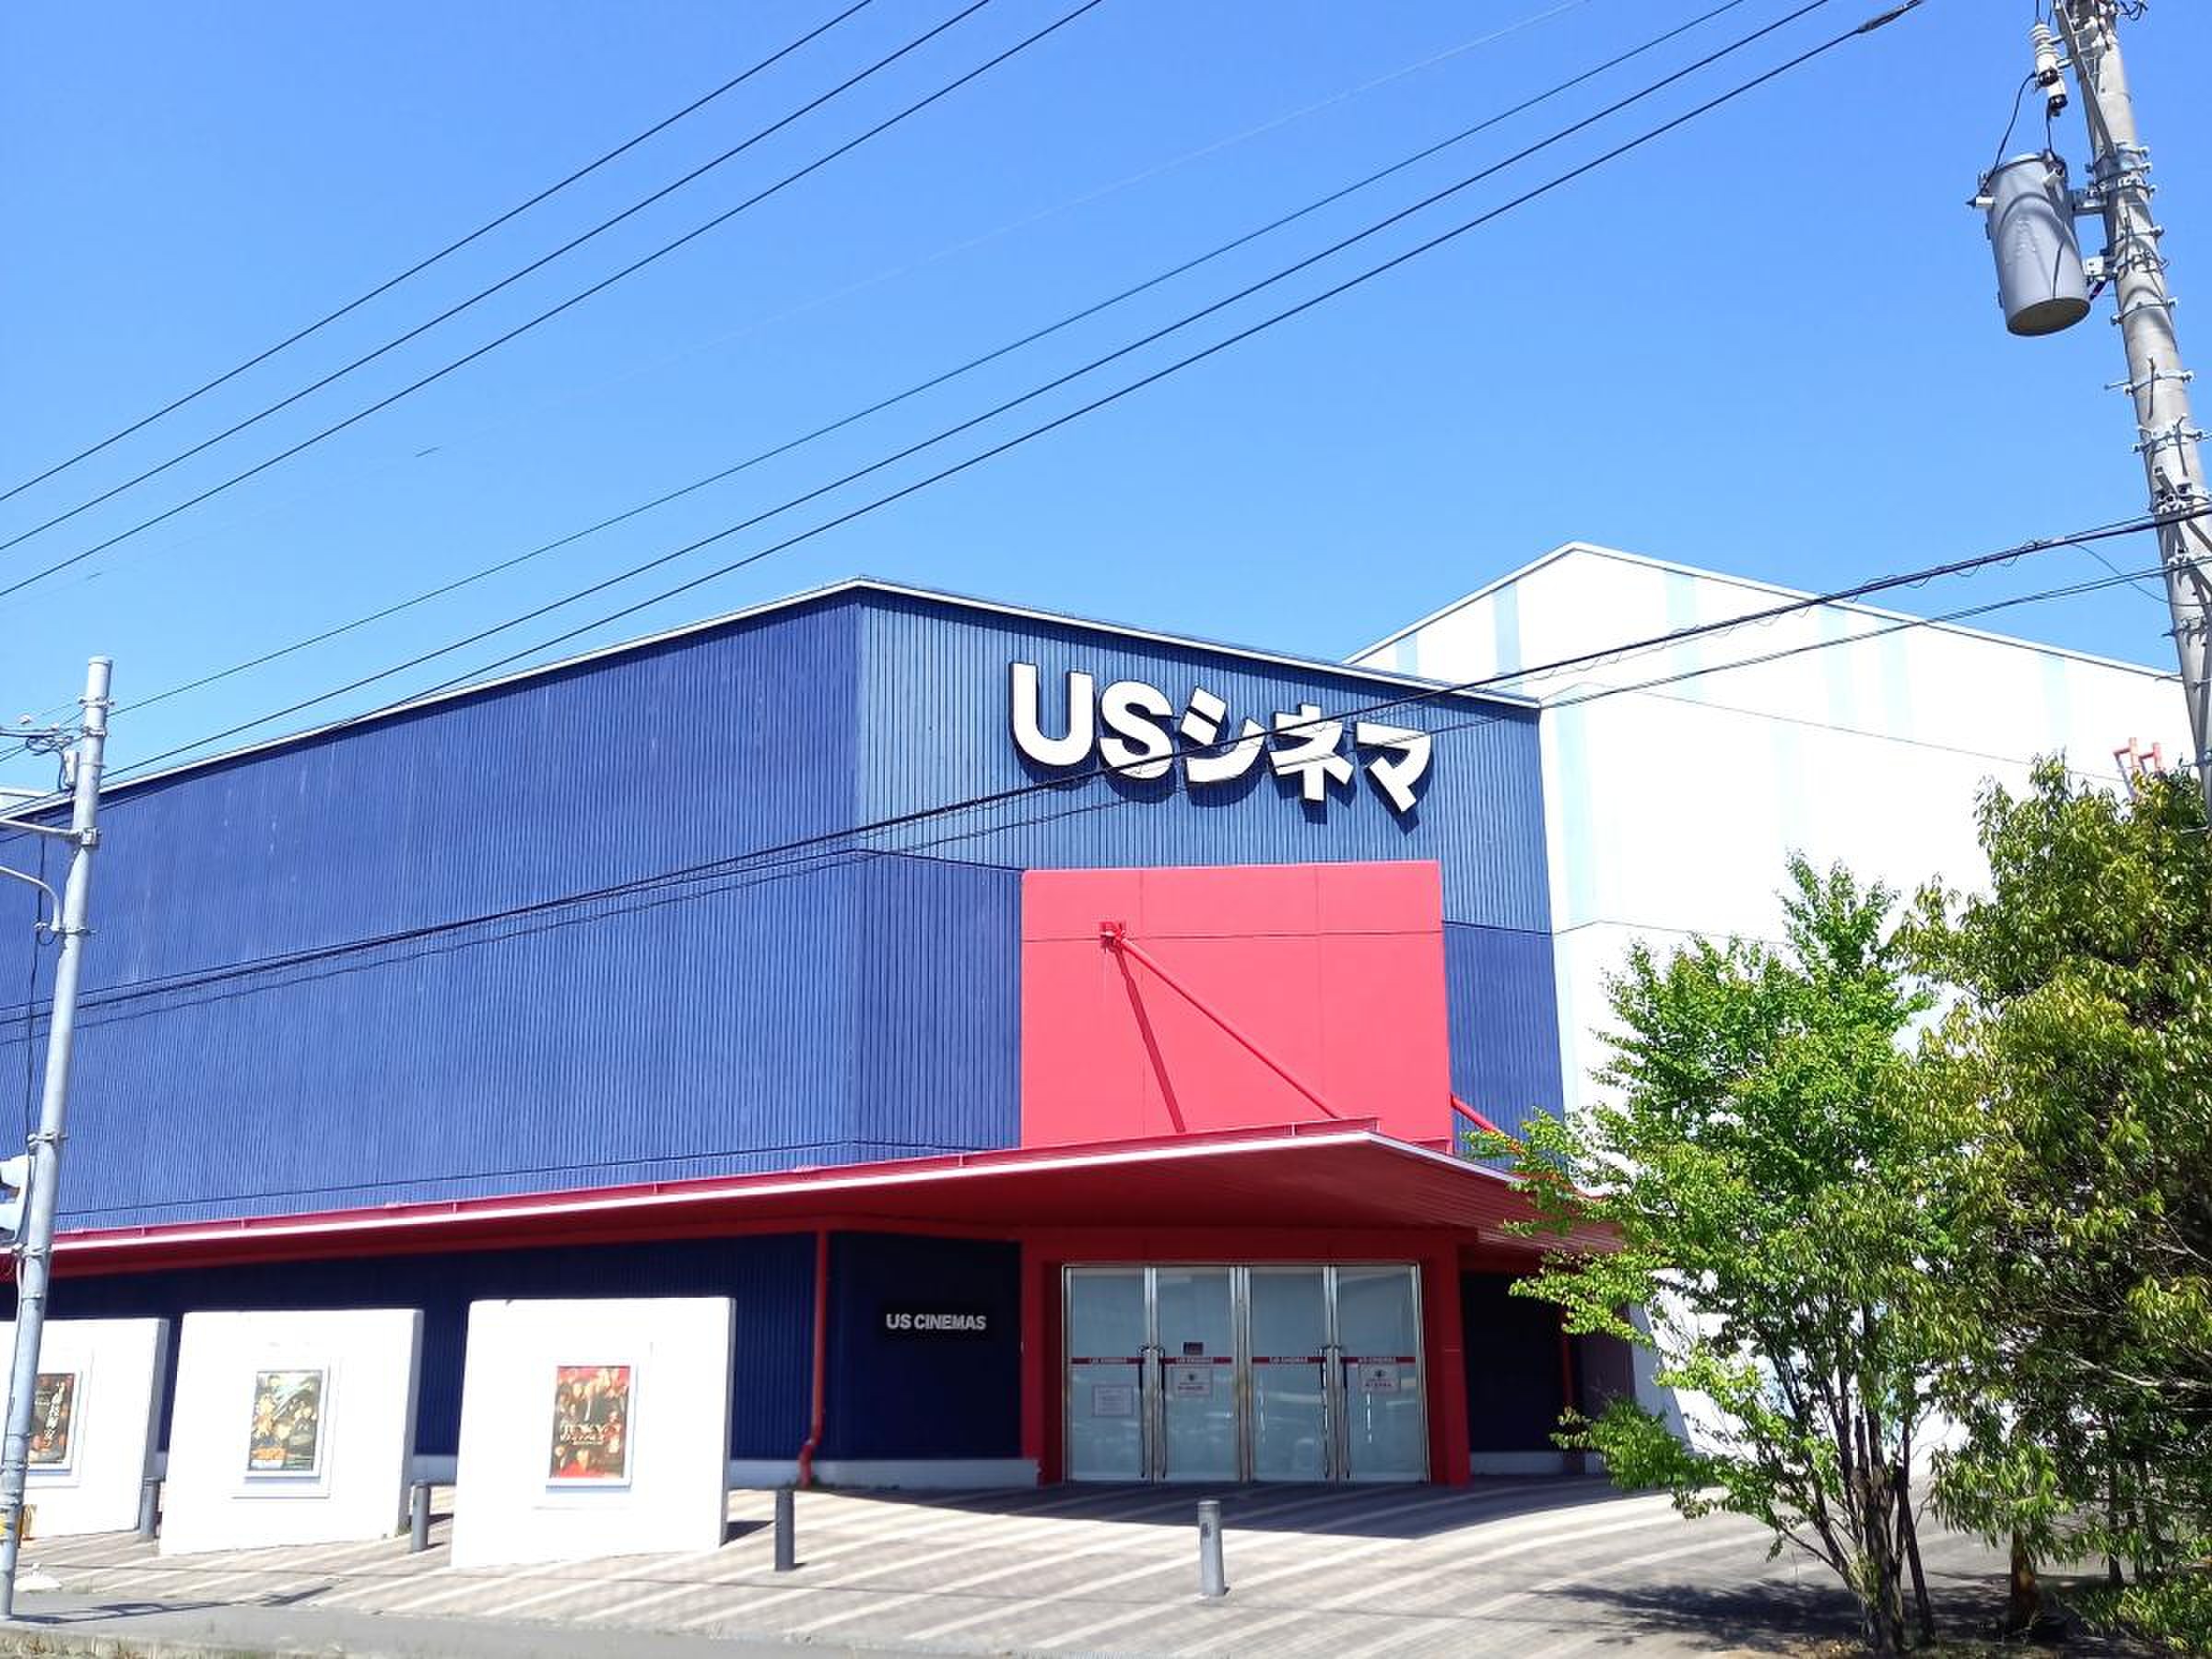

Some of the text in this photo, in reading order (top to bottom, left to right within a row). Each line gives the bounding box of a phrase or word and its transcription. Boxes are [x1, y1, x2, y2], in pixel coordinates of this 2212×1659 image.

[1011, 662, 1431, 812] USシネマ
[886, 1312, 987, 1330] US CINEMAS
